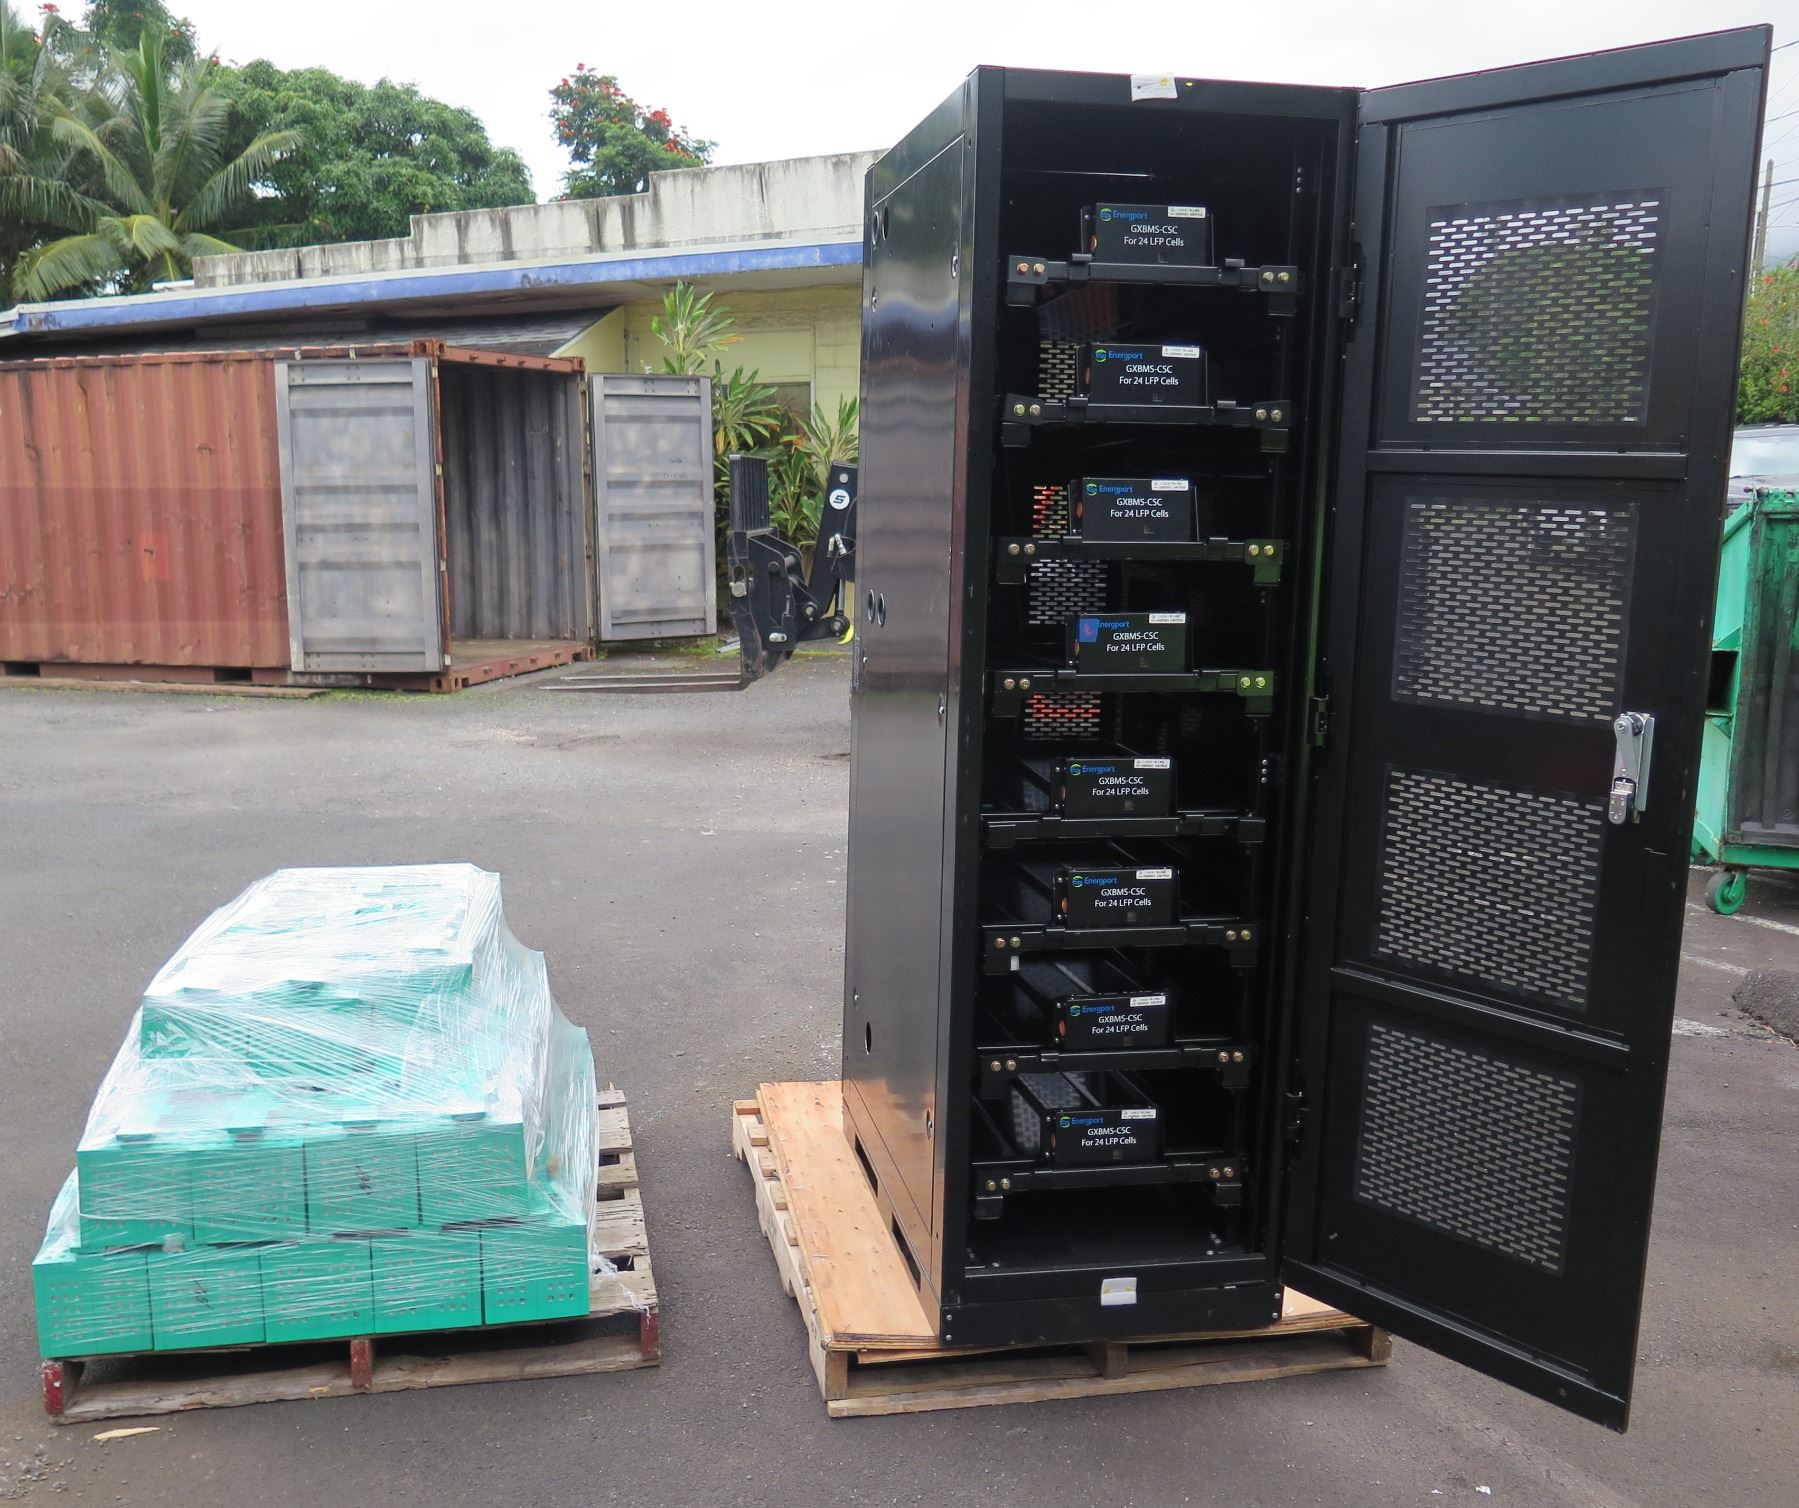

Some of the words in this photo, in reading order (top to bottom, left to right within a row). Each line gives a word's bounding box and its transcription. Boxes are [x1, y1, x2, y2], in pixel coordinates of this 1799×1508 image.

[1113, 209, 1147, 220] Energport
[1130, 225, 1178, 234] GXBMS-CSC
[1124, 237, 1136, 245] For
[1139, 237, 1148, 245] 24
[1150, 238, 1164, 246] LFP
[1166, 238, 1184, 246] Cells
[1109, 351, 1143, 361] Energport
[1126, 365, 1173, 374] GXBMS-CSC
[1119, 376, 1132, 384] For
[1145, 377, 1159, 385] LFP
[1161, 377, 1179, 385] Cells
[1099, 485, 1132, 495] Energport
[1116, 498, 1162, 506] GXBMS-CSC
[1110, 510, 1123, 518] For
[1124, 510, 1134, 518] 24
[1136, 510, 1149, 518] LFP
[1151, 510, 1169, 518] Cells
[1113, 632, 1159, 641] GXBMS-CSC
[1107, 644, 1119, 652] For
[1121, 644, 1130, 652] 24
[1132, 643, 1145, 651] LFP
[1147, 643, 1165, 651] Cells
[1082, 766, 1115, 774] Energport
[1099, 777, 1143, 785] GXBMS-CSC
[1092, 788, 1104, 796] For
[1132, 787, 1149, 795] Cells
[1084, 877, 1117, 886] Energport
[1101, 888, 1145, 896] GXBMS-CSC
[1095, 899, 1107, 907] For
[1108, 899, 1118, 907] 24
[1134, 898, 1151, 906] Cells
[1083, 1005, 1114, 1013] Energport
[1099, 1014, 1142, 1023] GXBMS-CSC
[1116, 1025, 1129, 1033] LFP
[1131, 1024, 1148, 1032] Cells
[1072, 1117, 1103, 1125] Energport
[1088, 1127, 1131, 1135] GXBMS-CSC
[1082, 1139, 1093, 1147] For
[1120, 1137, 1136, 1145] Cells
